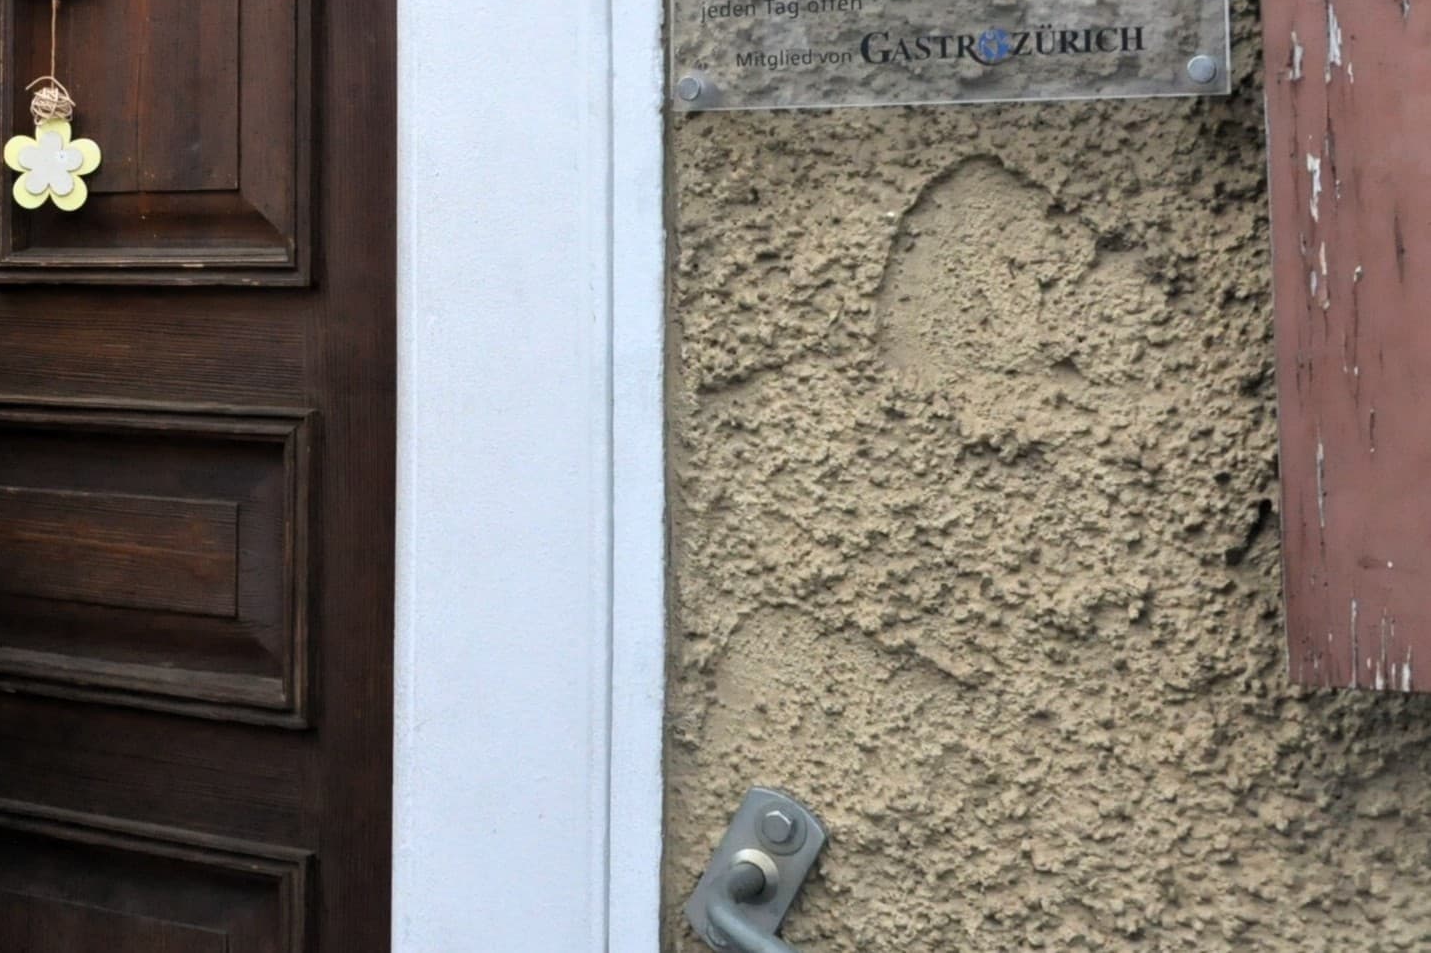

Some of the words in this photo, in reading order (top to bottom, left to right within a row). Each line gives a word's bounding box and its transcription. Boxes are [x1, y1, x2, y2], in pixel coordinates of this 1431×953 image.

[700, 0, 756, 24] jeden
[736, 49, 812, 70] Mitglied
[818, 49, 853, 65] von
